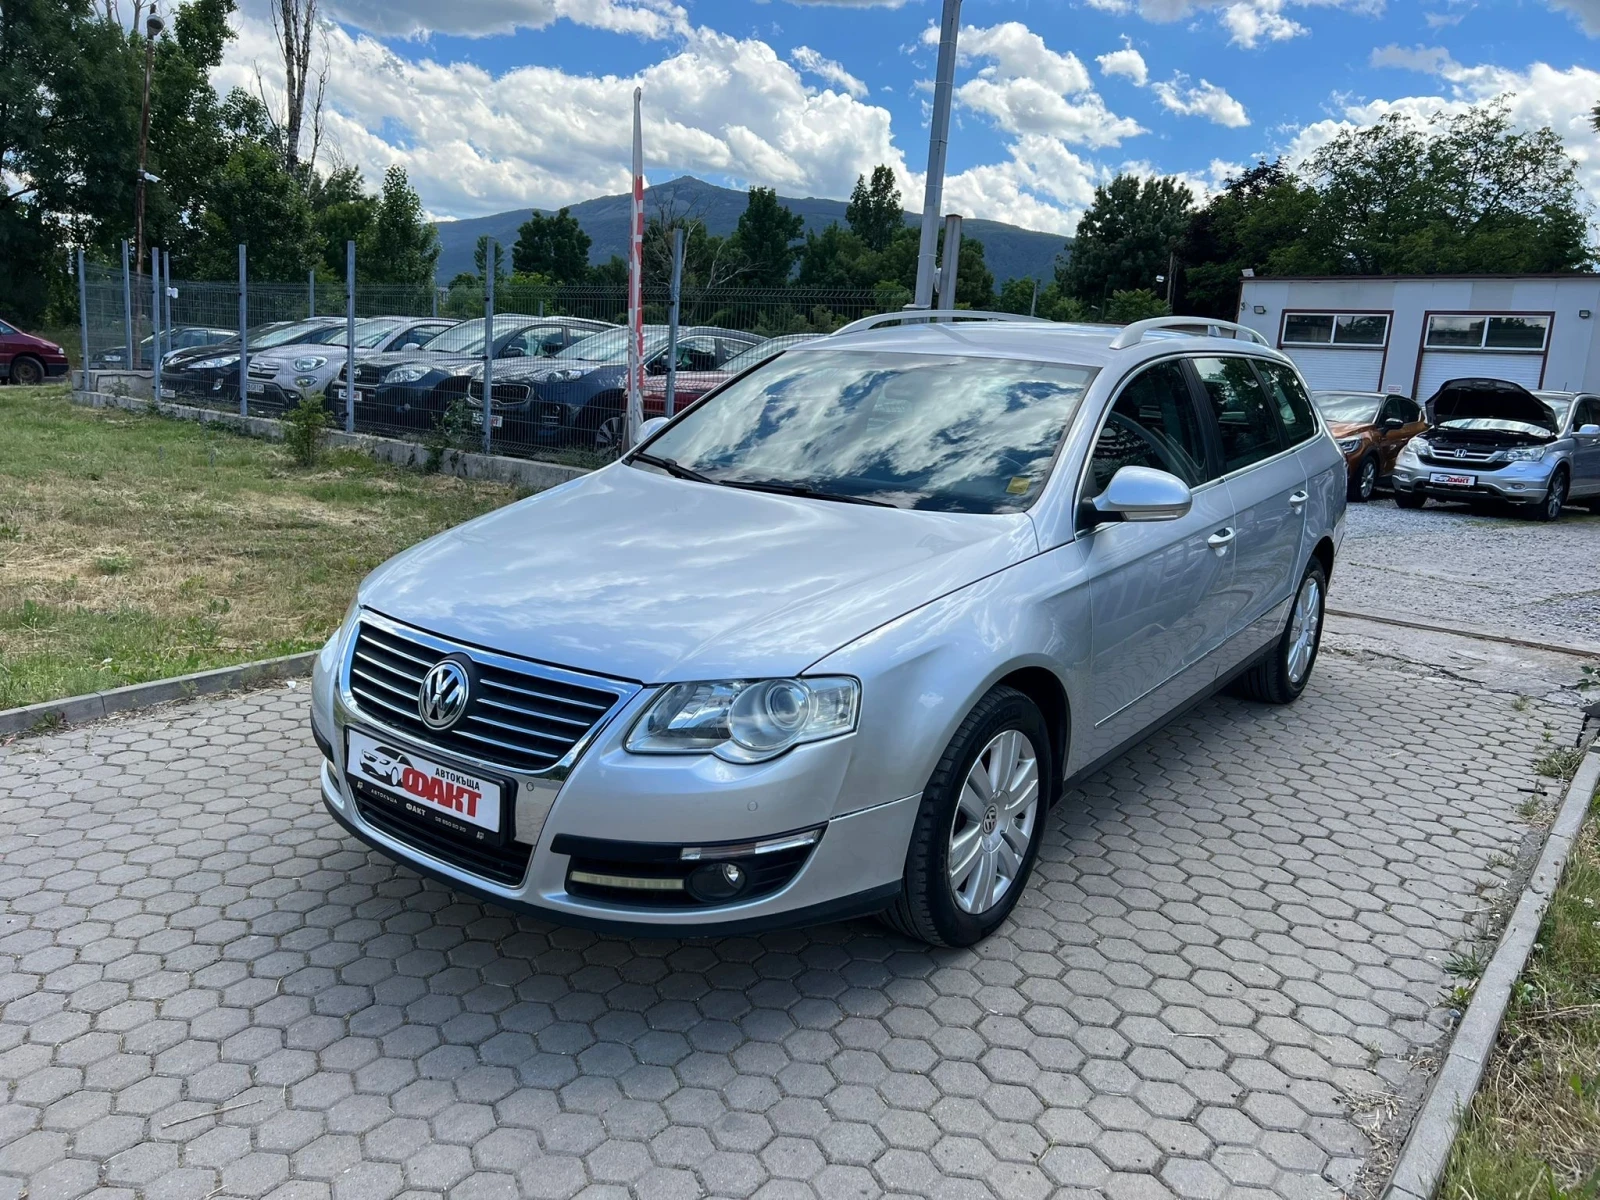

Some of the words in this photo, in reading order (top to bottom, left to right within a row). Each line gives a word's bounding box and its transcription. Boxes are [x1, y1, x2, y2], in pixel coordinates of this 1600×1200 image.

[435, 767, 481, 791] АВТОКЪЩА
[402, 767, 482, 818] ФАКТ
[405, 802, 426, 816] ФАКТ
